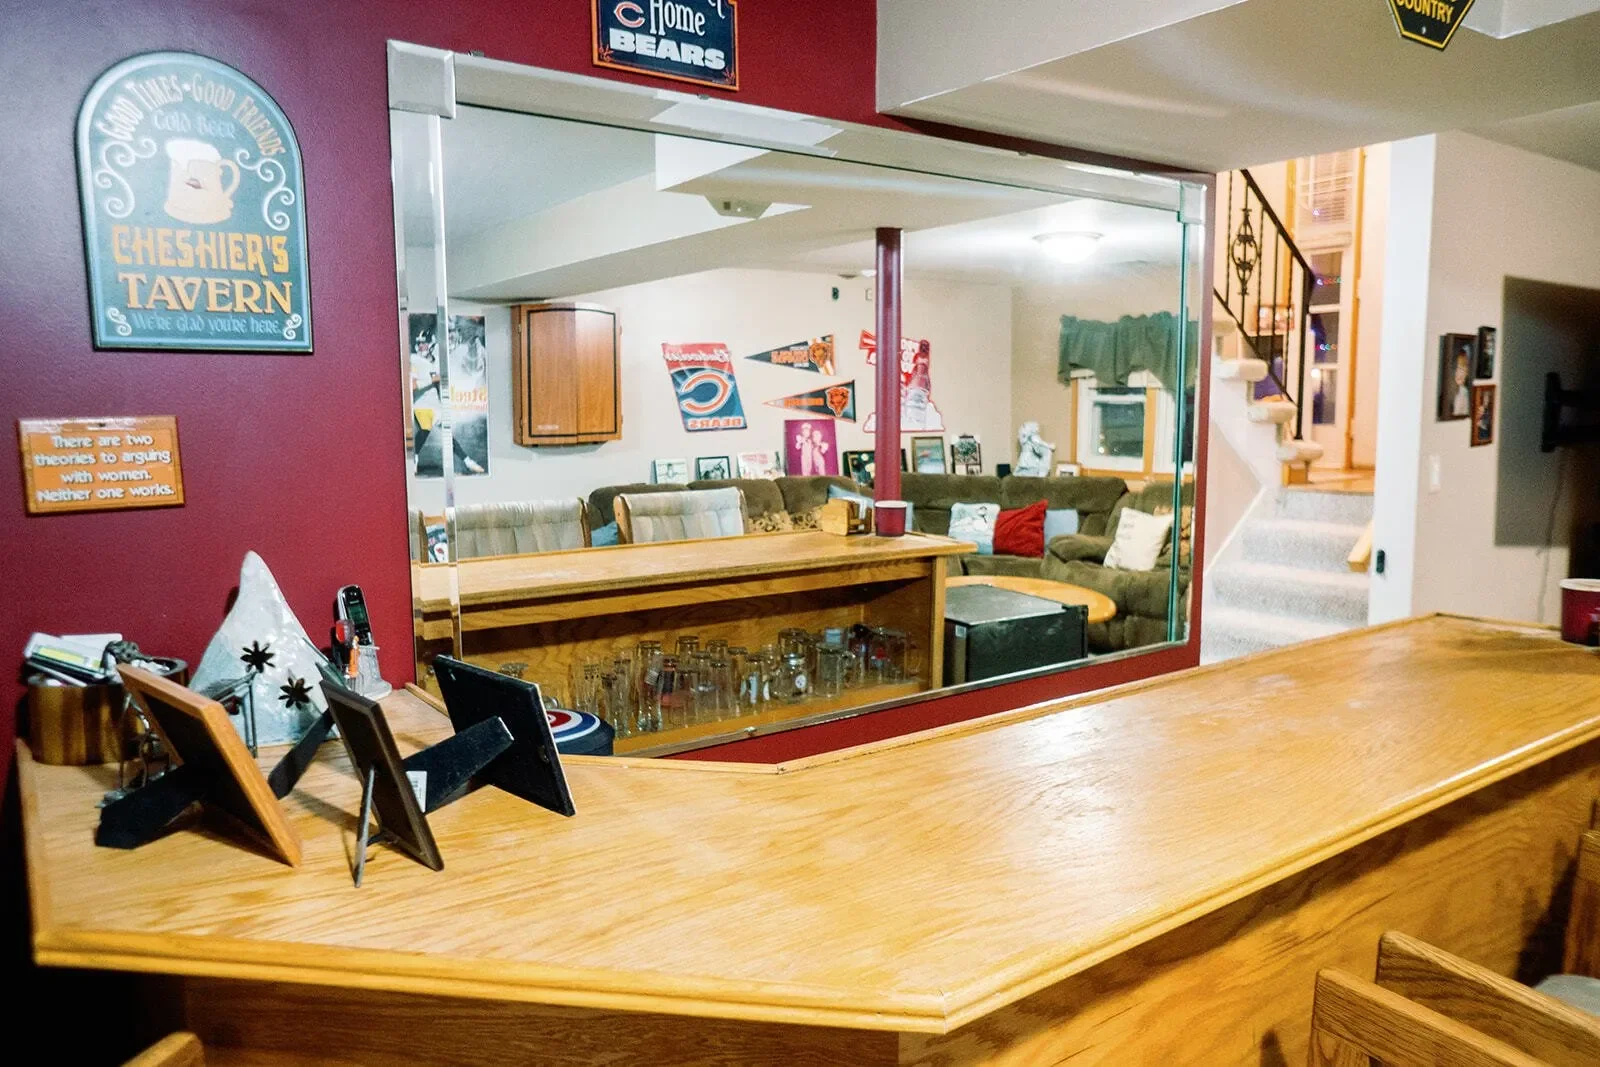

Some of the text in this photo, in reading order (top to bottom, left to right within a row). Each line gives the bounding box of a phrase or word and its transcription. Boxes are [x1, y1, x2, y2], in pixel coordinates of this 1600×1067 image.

[650, 0, 706, 36] Home
[609, 28, 726, 70] BEARS
[96, 73, 286, 156] GOOD TIMES GOOD FRIENDS
[112, 225, 289, 277] CHESHIER'S
[118, 273, 293, 314] TAVERN
[176, 316, 205, 334] glad
[52, 434, 154, 448] There are two
[35, 450, 171, 465] theories to arguing
[61, 469, 152, 483] with women.
[38, 484, 174, 502] Neither one works.
